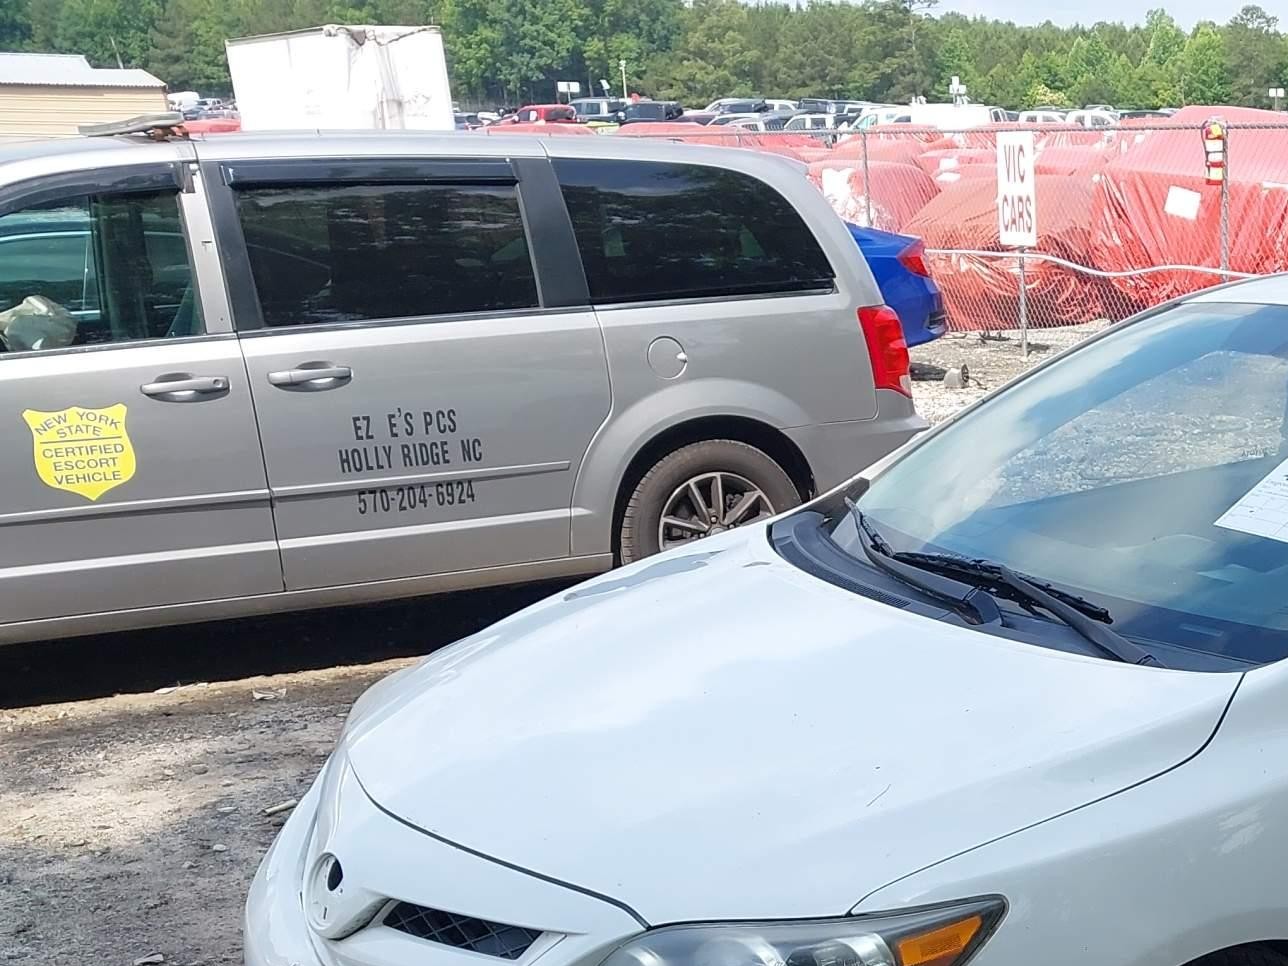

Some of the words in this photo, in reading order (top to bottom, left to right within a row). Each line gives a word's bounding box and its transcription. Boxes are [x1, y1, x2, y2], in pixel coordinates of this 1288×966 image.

[1003, 144, 1026, 184] VIC
[1002, 194, 1033, 233] CARS
[35, 413, 68, 436] NEW
[76, 411, 121, 431] YORK
[56, 423, 102, 439] STATE
[352, 415, 374, 441] EZ
[387, 407, 415, 438] E'S
[422, 409, 457, 436] PCS
[42, 443, 125, 459] CERTIFIED
[53, 457, 119, 472] ESCORT
[338, 445, 393, 473] HOLLY
[400, 440, 450, 468] RIDGE
[460, 438, 483, 463] NC
[53, 470, 122, 486] VEHICLE
[358, 480, 476, 515] 570-204-6924
